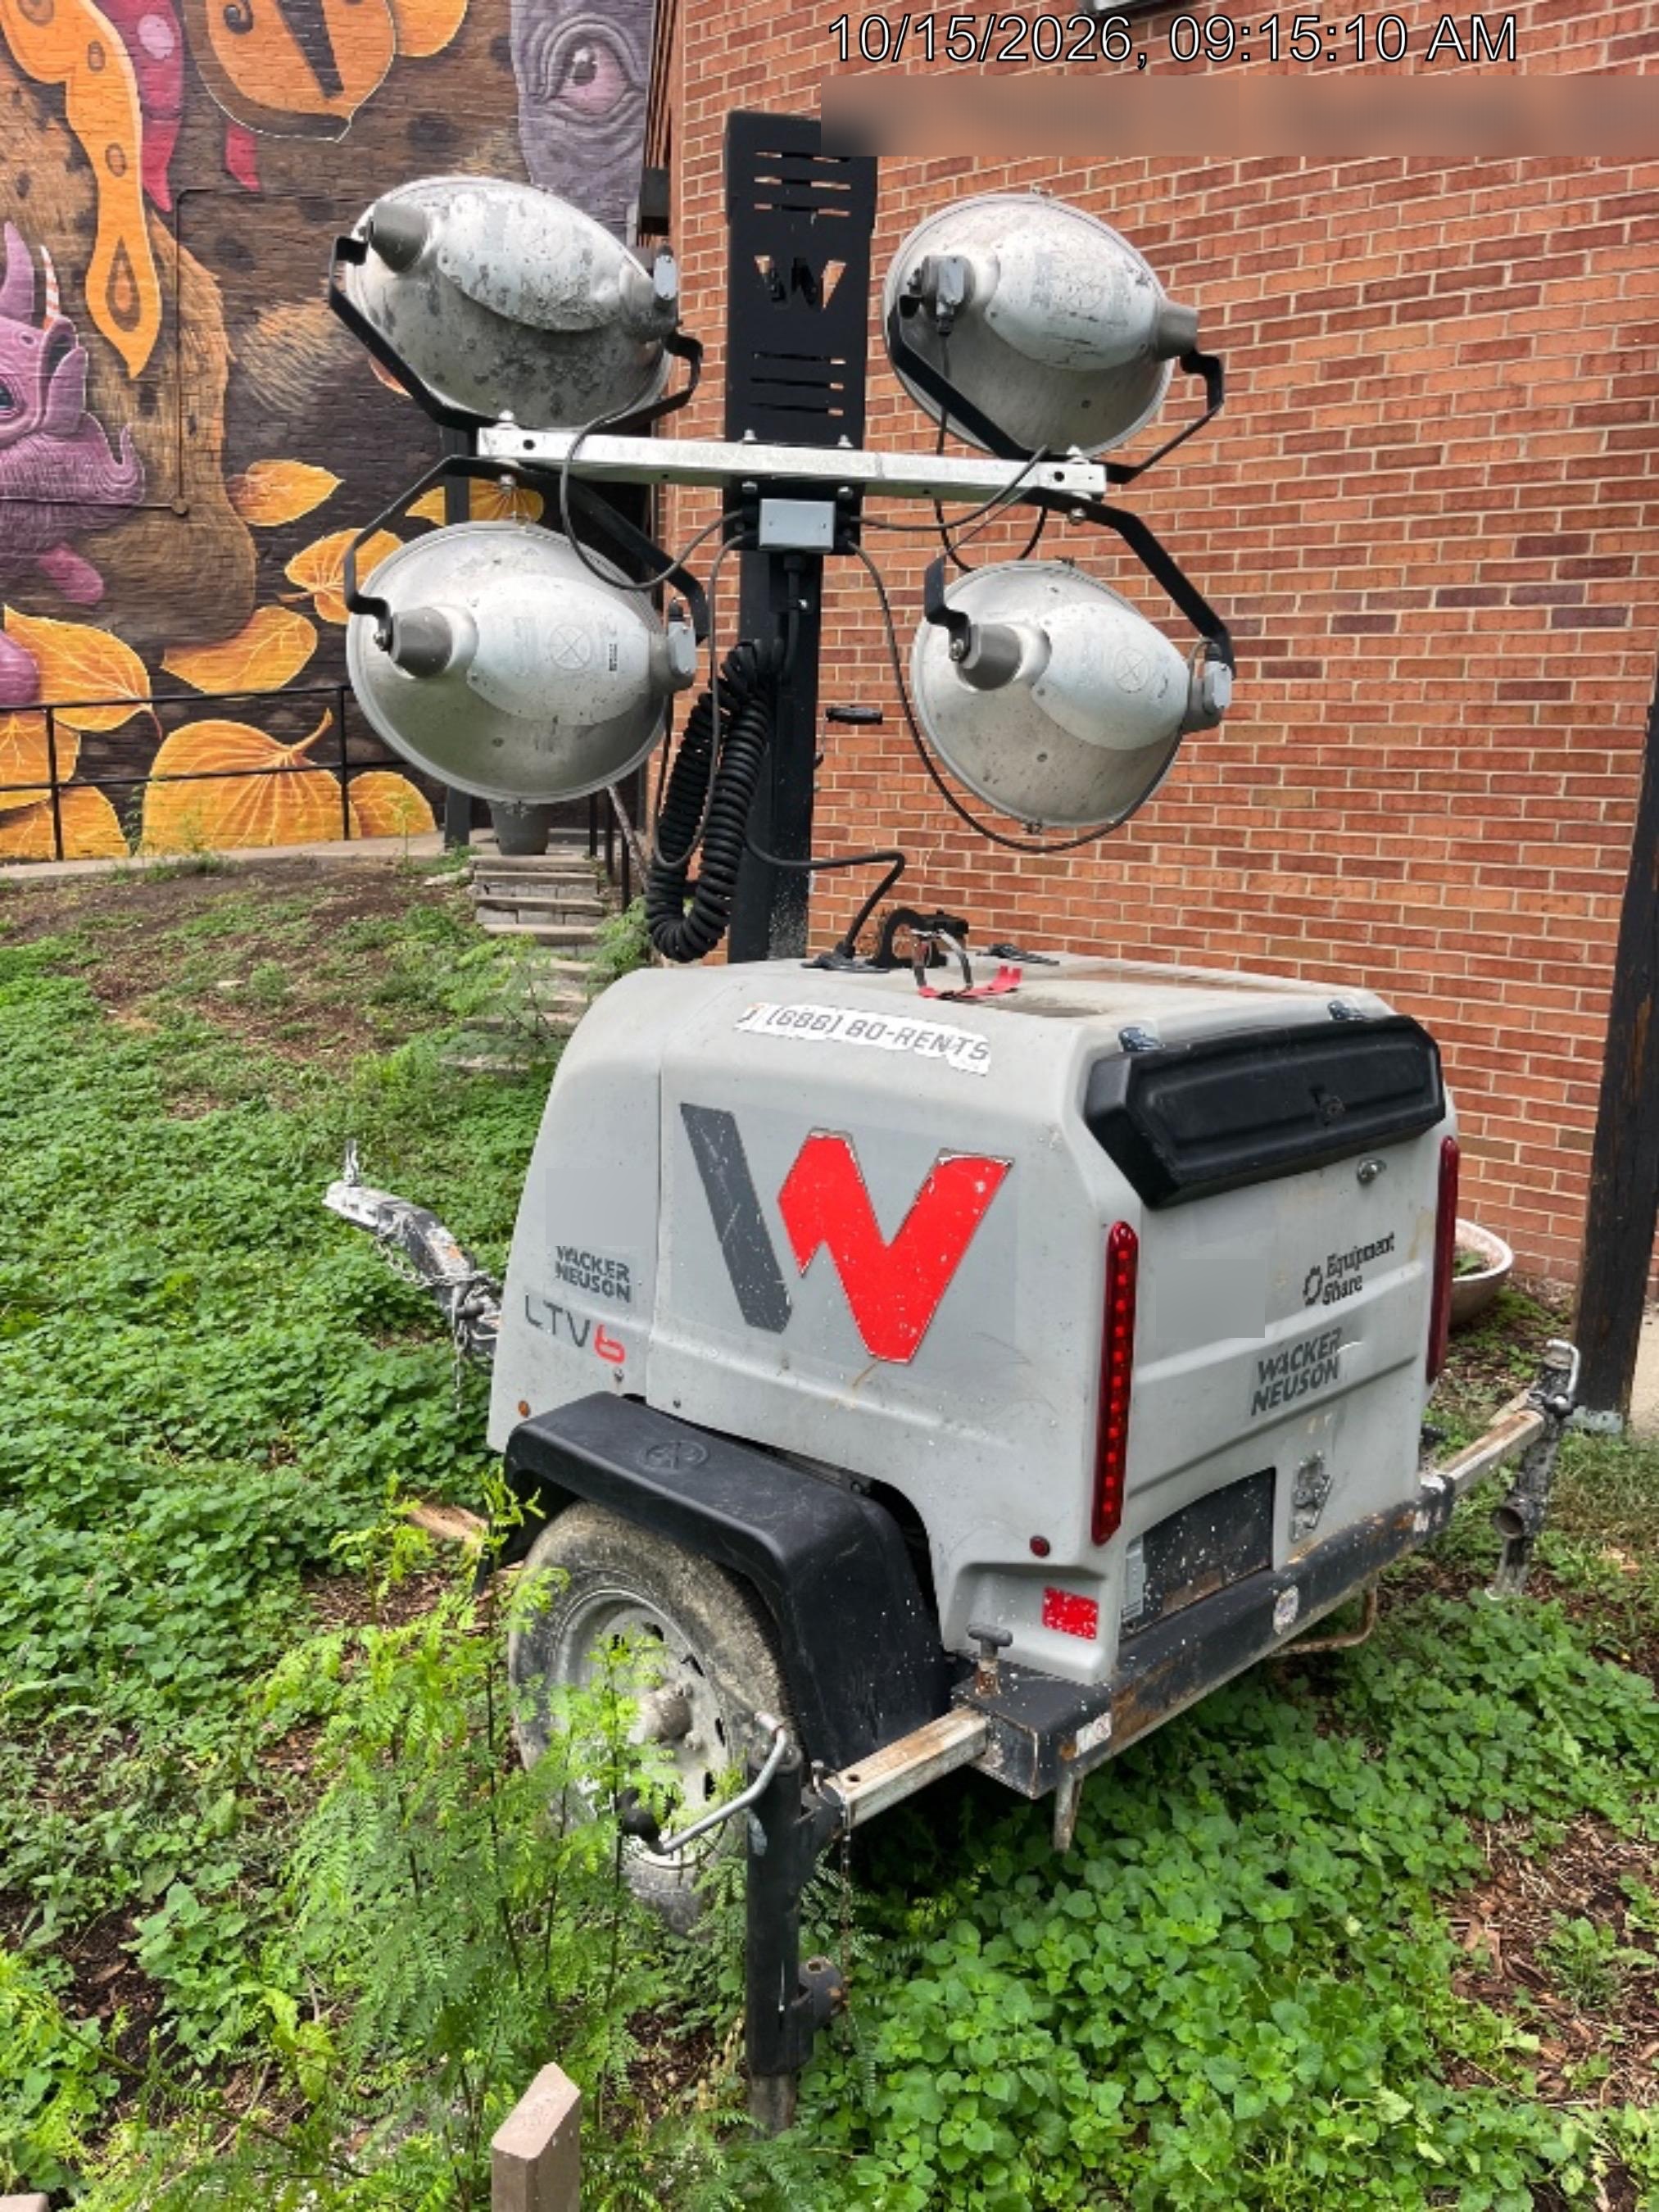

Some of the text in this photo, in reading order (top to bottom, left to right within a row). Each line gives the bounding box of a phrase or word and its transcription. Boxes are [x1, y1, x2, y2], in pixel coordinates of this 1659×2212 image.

[555, 1245, 630, 1284] WACKER
[1326, 1231, 1394, 1278] Equipment
[555, 1261, 631, 1303] NEUSON
[1321, 1275, 1362, 1305] Share
[524, 1294, 626, 1365] LTV6
[1258, 1327, 1343, 1385] WACKER
[1251, 1354, 1340, 1416] NEUSON
